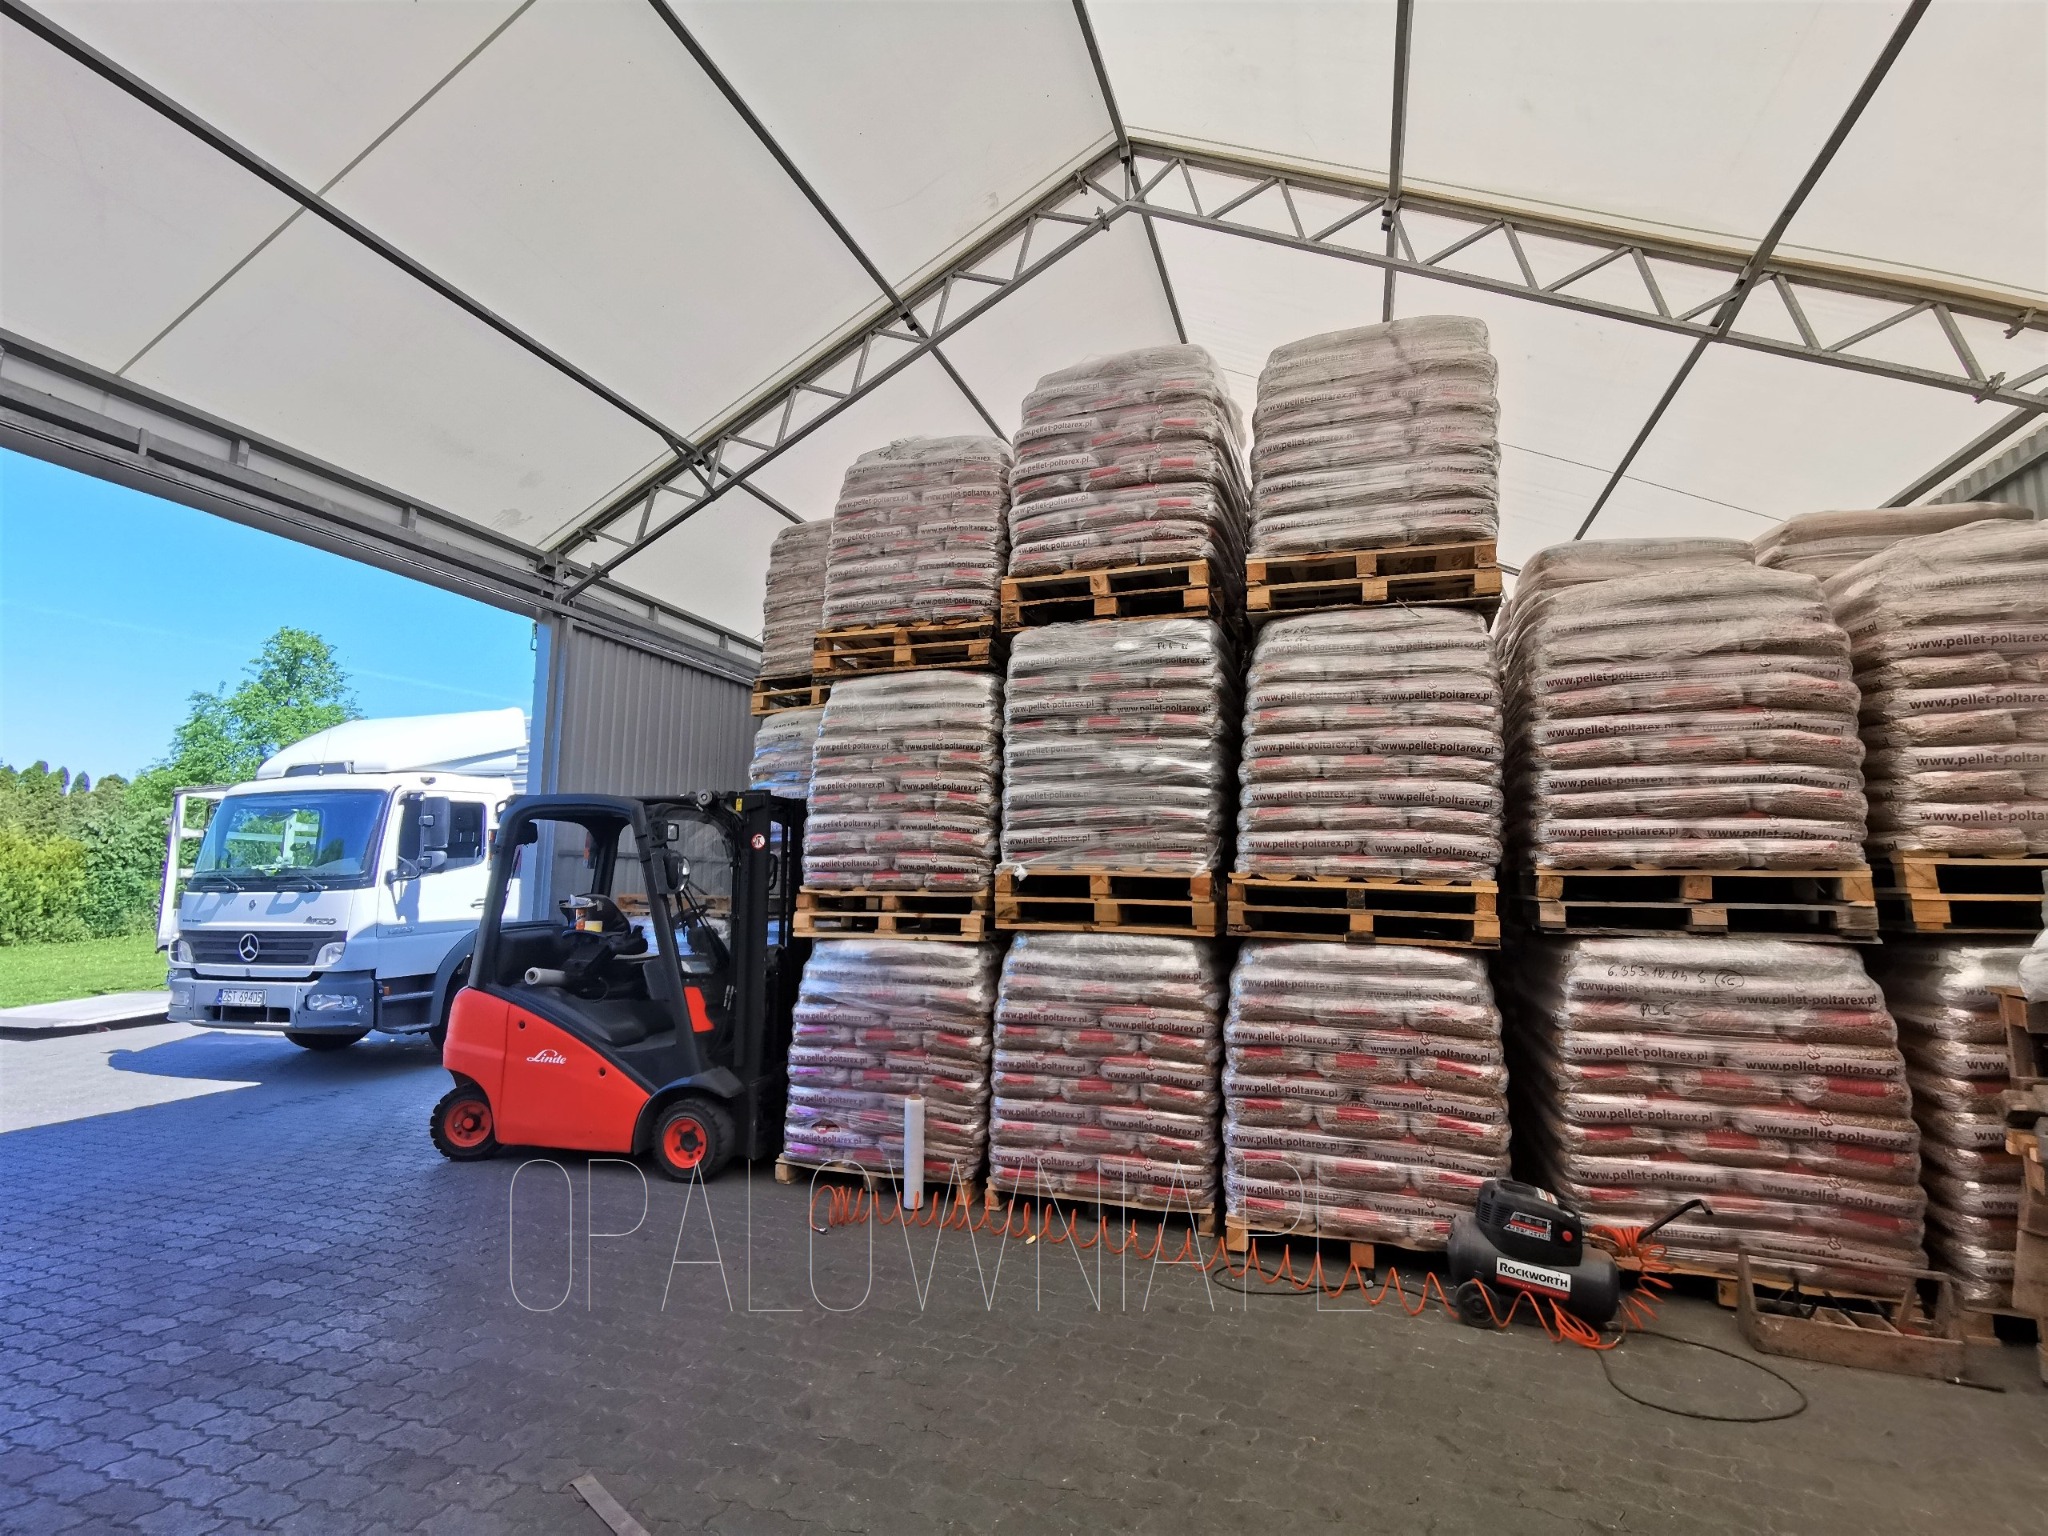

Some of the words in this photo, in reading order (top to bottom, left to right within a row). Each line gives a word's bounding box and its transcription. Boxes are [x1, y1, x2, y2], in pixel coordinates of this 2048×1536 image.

[1014, 538, 1090, 554] ww.pellet-poltarex.pl
[1546, 669, 1672, 688] www.pellet-poltarex.pl
[1381, 690, 1492, 701] www.pellet-poltarex.pl
[1910, 692, 2046, 710] www.pellet-poltare
[905, 743, 983, 751] www.pellet-poltarex.pl
[1254, 740, 1359, 752] www.pellet-poltarex.pl
[1381, 741, 1494, 754] www.pellet-poltarex.pl
[815, 782, 884, 791] ww.pellet-poltarex.pl
[1549, 776, 1678, 789] www.pellet-poltarex.pl
[1252, 789, 1356, 801] www.pellet-poltarex.pl
[1379, 791, 1493, 809] www.pellet-poltarex.pl
[1920, 811, 2048, 822] www.pellet-polta
[1009, 834, 1090, 845] ww.pellet-poltarex.pl
[1548, 826, 1679, 838] www.pellet-poltarex.pl
[1707, 827, 1853, 842] www.pellet-poltarex.pl
[1248, 838, 1353, 848] www.pellet-poltarex.pl
[1375, 844, 1491, 859] www.pellet-poltarex.pl
[808, 859, 880, 869] ww.pellet-poltarex.pl
[223, 990, 237, 1002] ZST
[1736, 994, 1878, 1006] www.pellet-poltarex.pl
[1108, 1019, 1204, 1034] www.pellet-poltarex.pl
[1234, 1030, 1340, 1046] www.pellet-poltarex.pl
[526, 1048, 567, 1064] Linde
[1370, 1043, 1490, 1062] www.pellet-poltarex.pl
[1573, 1045, 1709, 1061] www.pellet-poltarex.pl
[1746, 1059, 1898, 1077] www.pellet-poltarex.pl
[1106, 1070, 1204, 1087] www.pellet-poltarex.pl
[1230, 1082, 1338, 1098] www.pellet-poltarex.pl
[1373, 1098, 1496, 1121] www.pellet-poltarex.pl
[1576, 1108, 1713, 1124] www.pellet-poltarex.pl
[1105, 1118, 1203, 1137] www.pellet-poltarex.pl
[786, 1133, 861, 1145] ww.pellet-poltarex.pl
[1231, 1132, 1340, 1150] www.pellet-poltarex.pl
[1754, 1123, 1912, 1148] www.pellet-poltarex.pl
[1579, 1169, 1718, 1185] www.pellet-poltarex.pl
